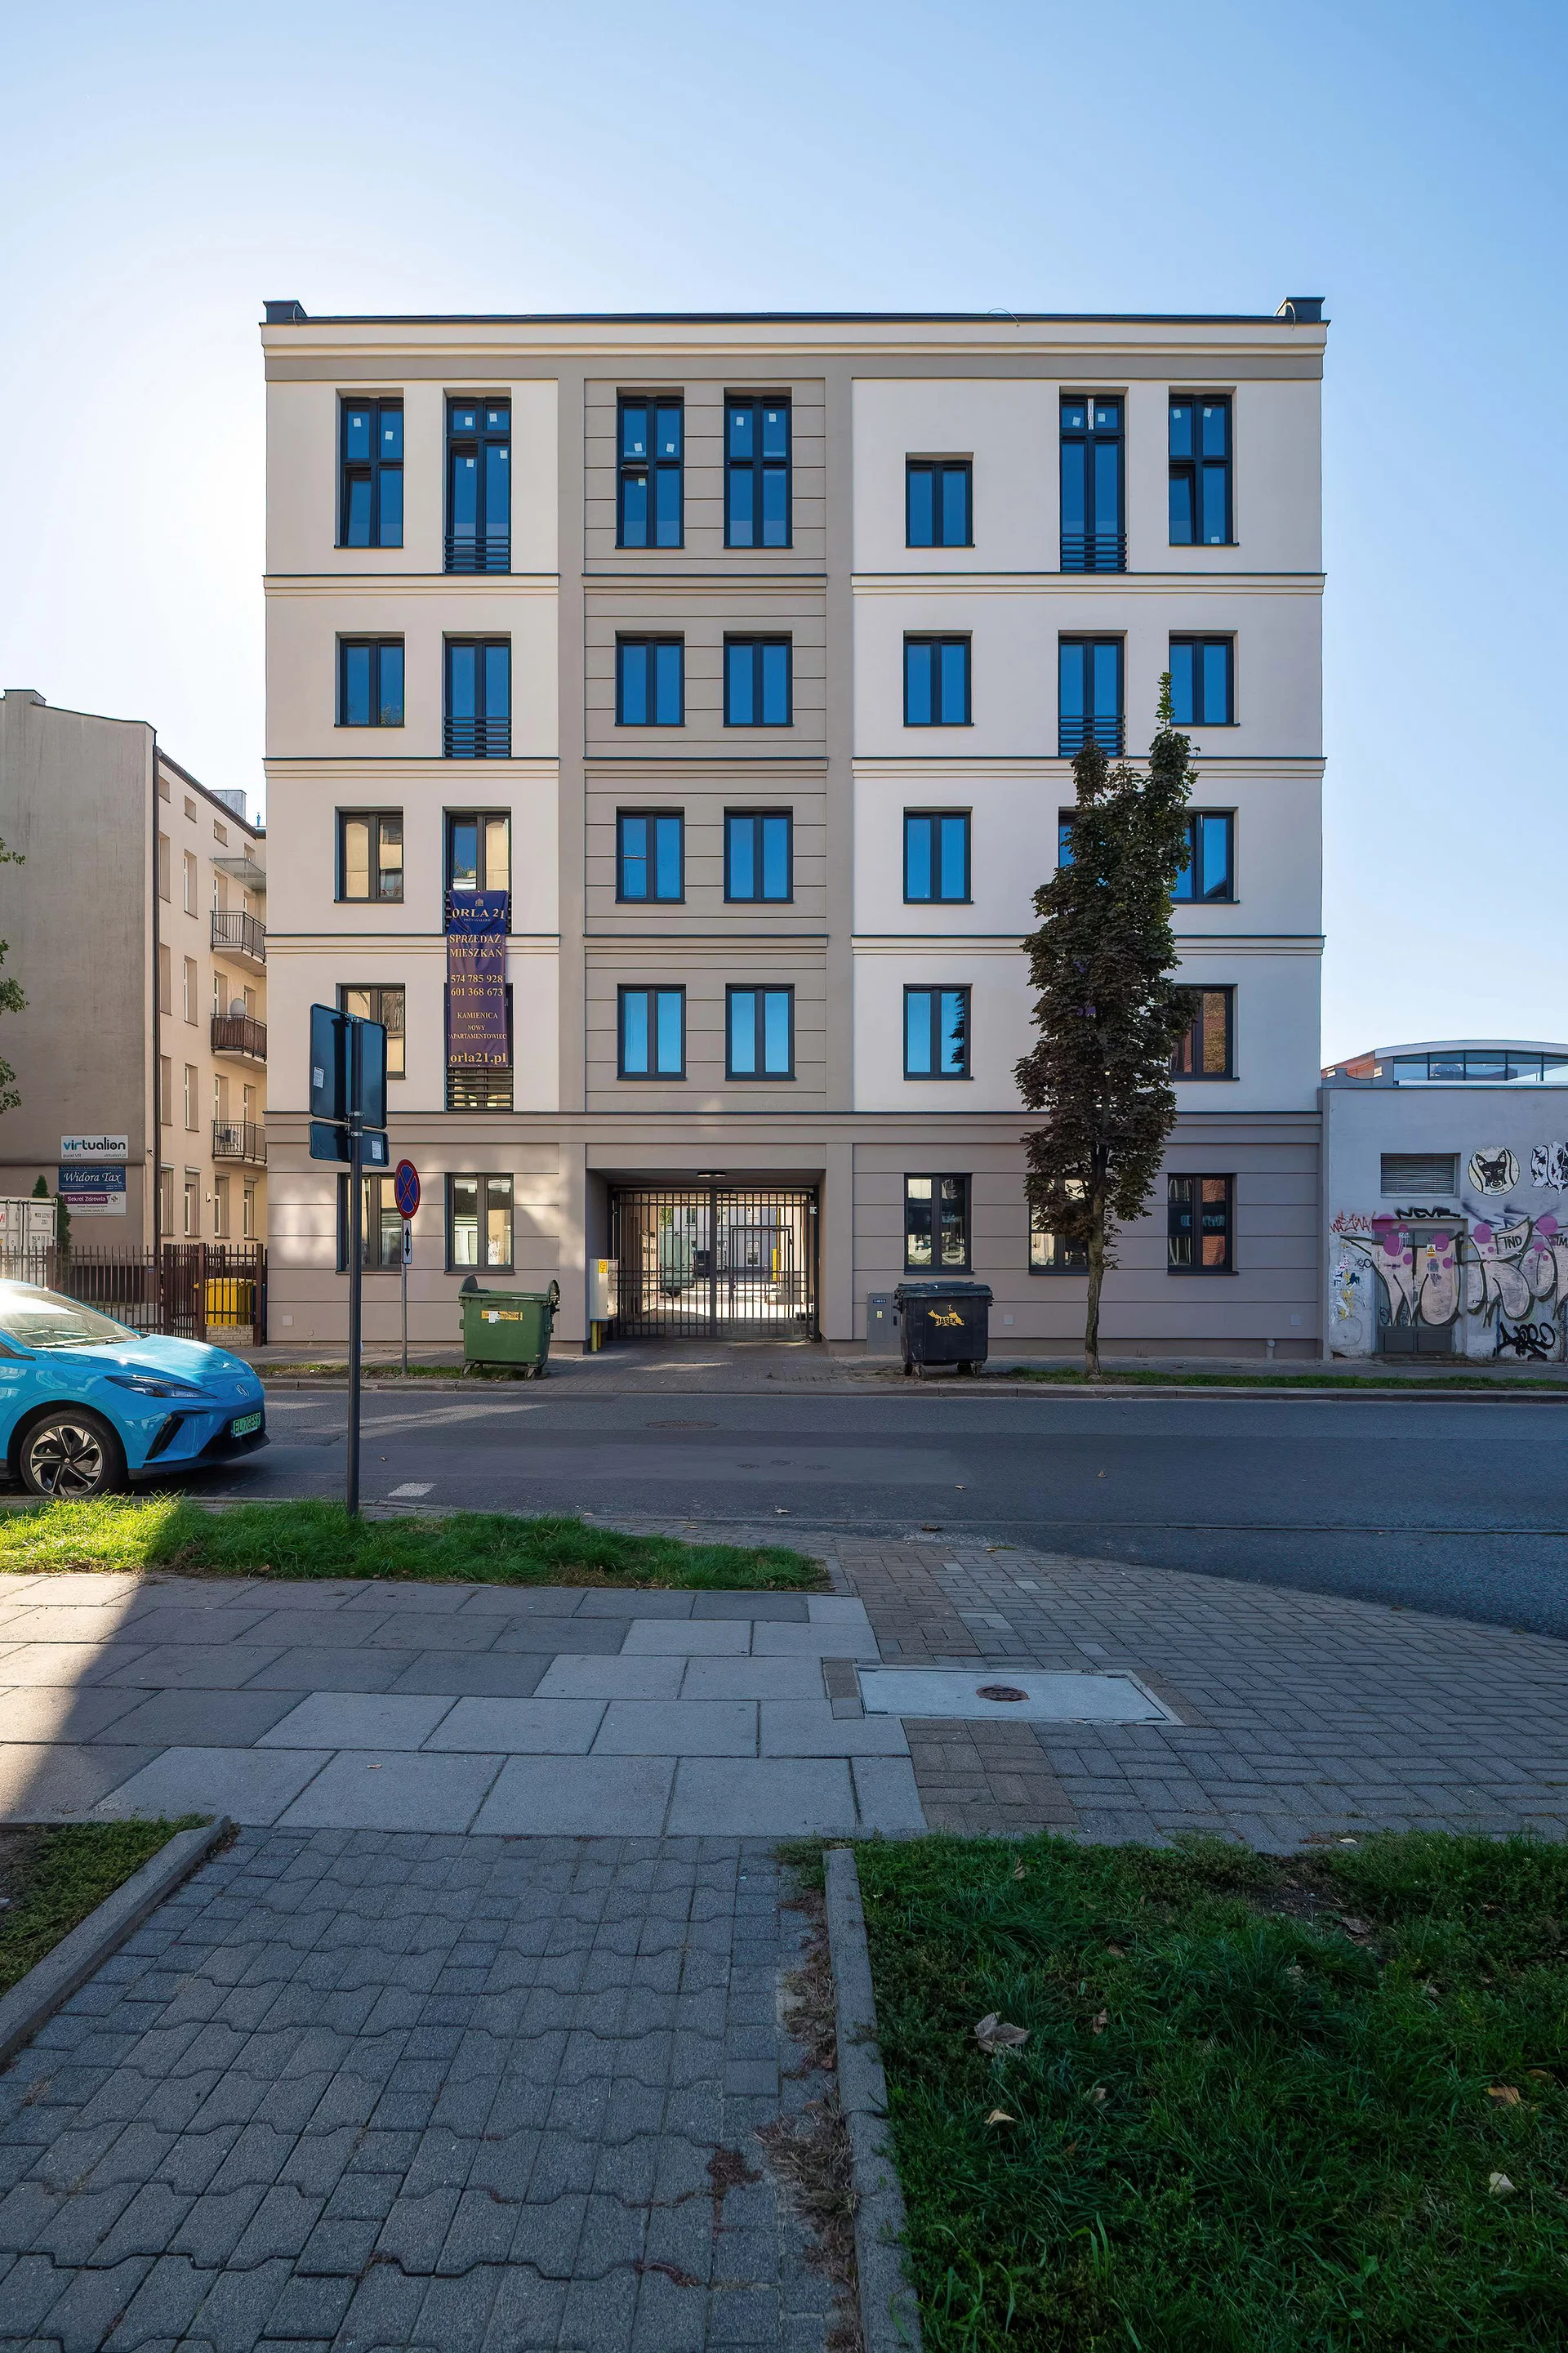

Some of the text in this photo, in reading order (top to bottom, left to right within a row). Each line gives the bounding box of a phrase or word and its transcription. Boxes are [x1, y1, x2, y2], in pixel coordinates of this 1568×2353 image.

[452, 908, 505, 919] ORLA 21
[449, 933, 501, 943] SPRZEDAŻ
[450, 946, 502, 957] MIESZKAŃ
[451, 974, 503, 983] 574 785 928
[451, 987, 503, 996] 601 368 673
[450, 1052, 506, 1065] orla21.pl
[63, 1137, 126, 1150] virtualion
[64, 1171, 122, 1183] Widora Tax
